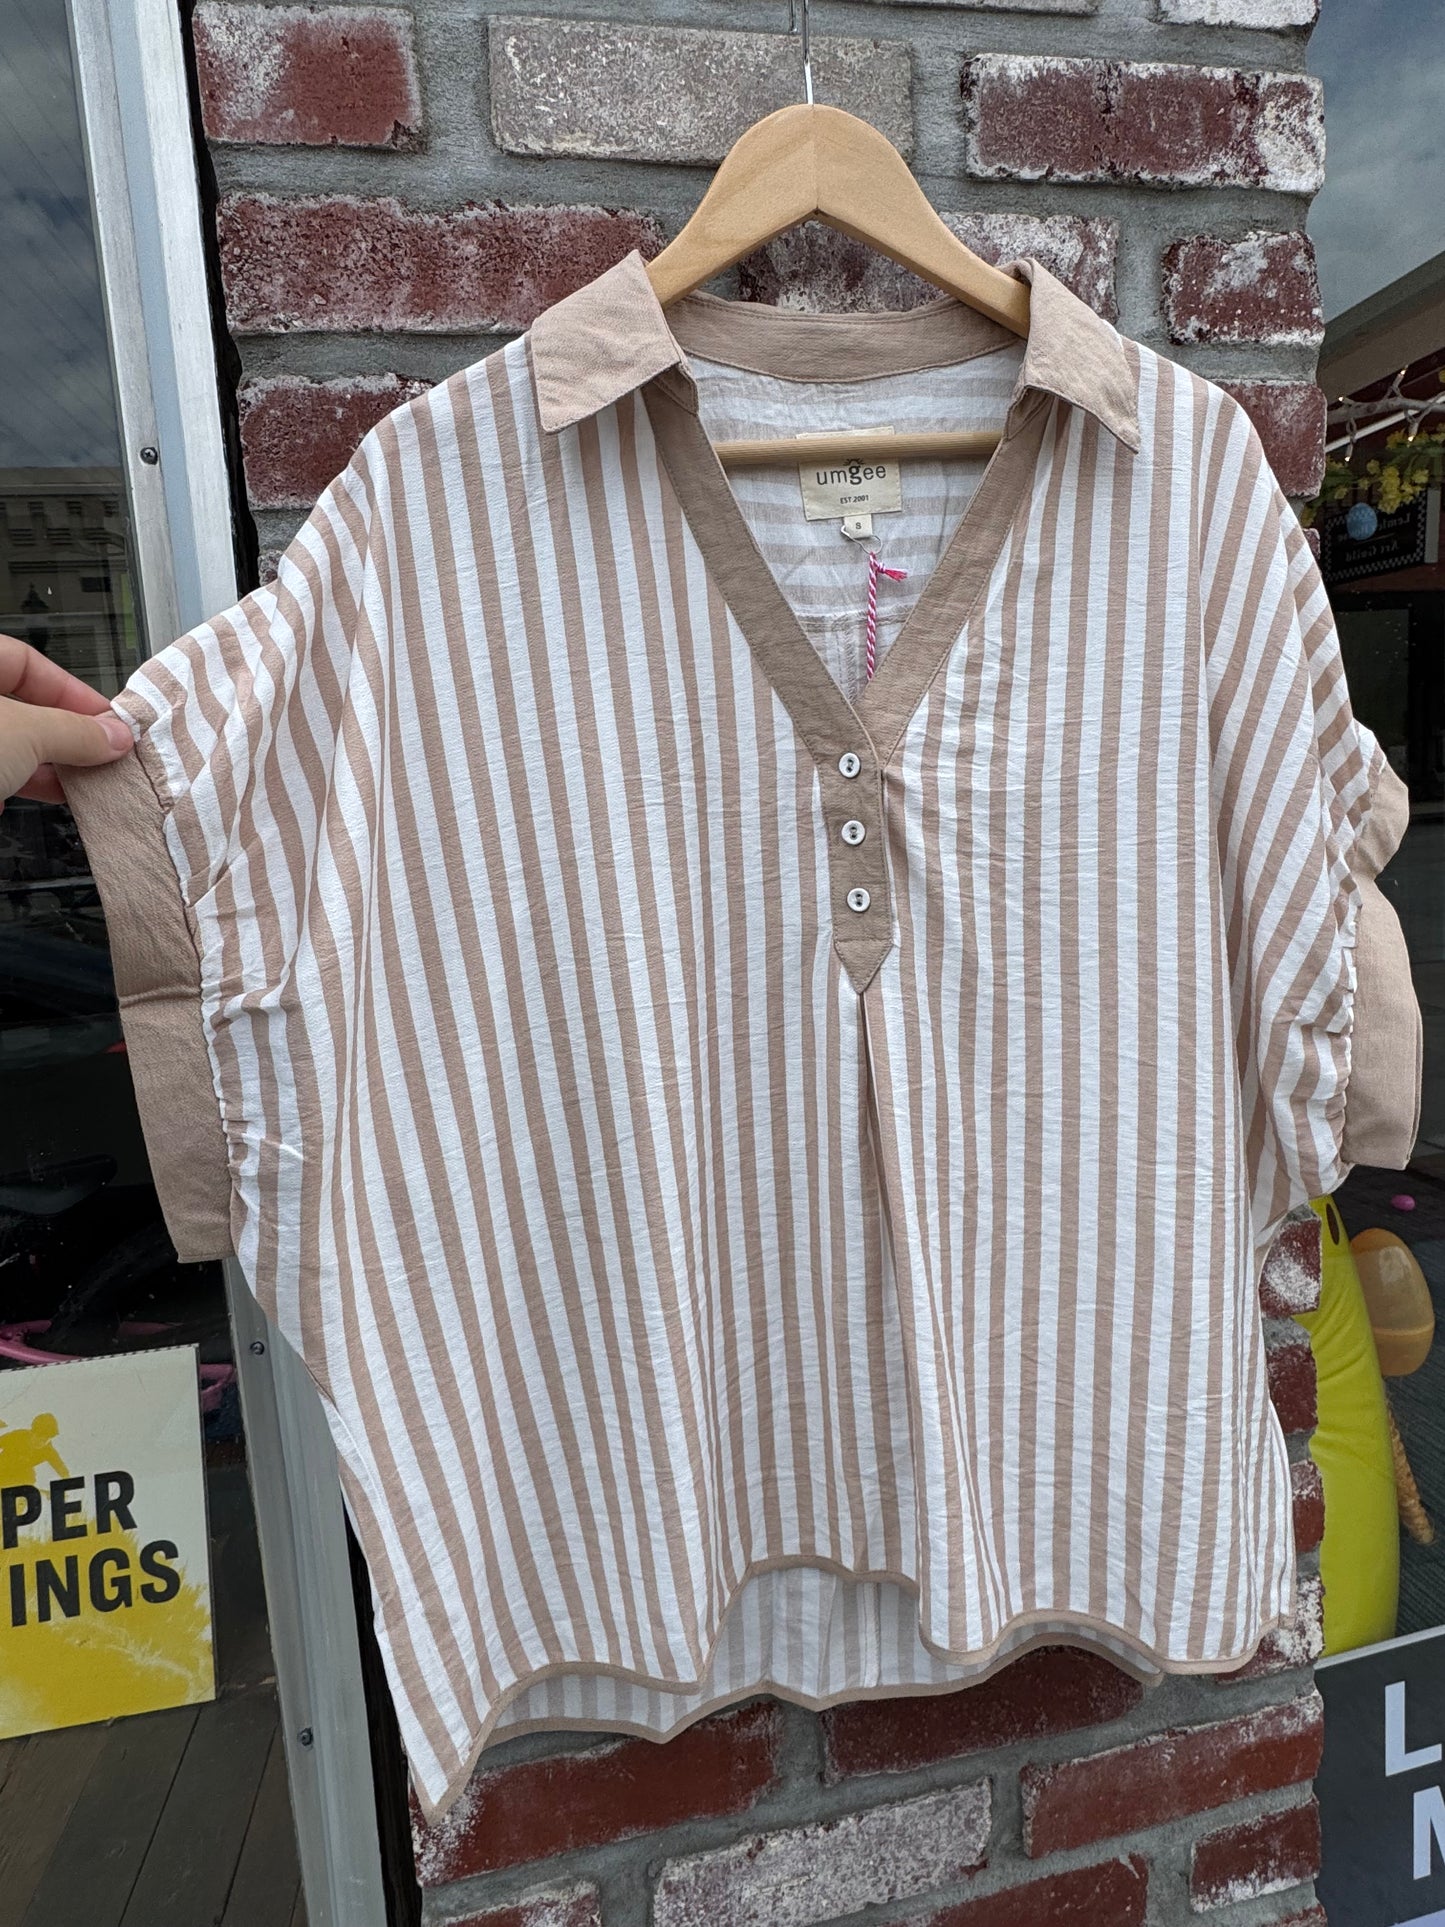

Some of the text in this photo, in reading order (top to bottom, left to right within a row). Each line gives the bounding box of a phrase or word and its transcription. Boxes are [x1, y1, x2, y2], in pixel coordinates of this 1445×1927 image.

[816, 465, 887, 485] umgee
[855, 522, 862, 530] S
[1, 1471, 137, 1549] PER
[9, 1540, 181, 1628] INGS
